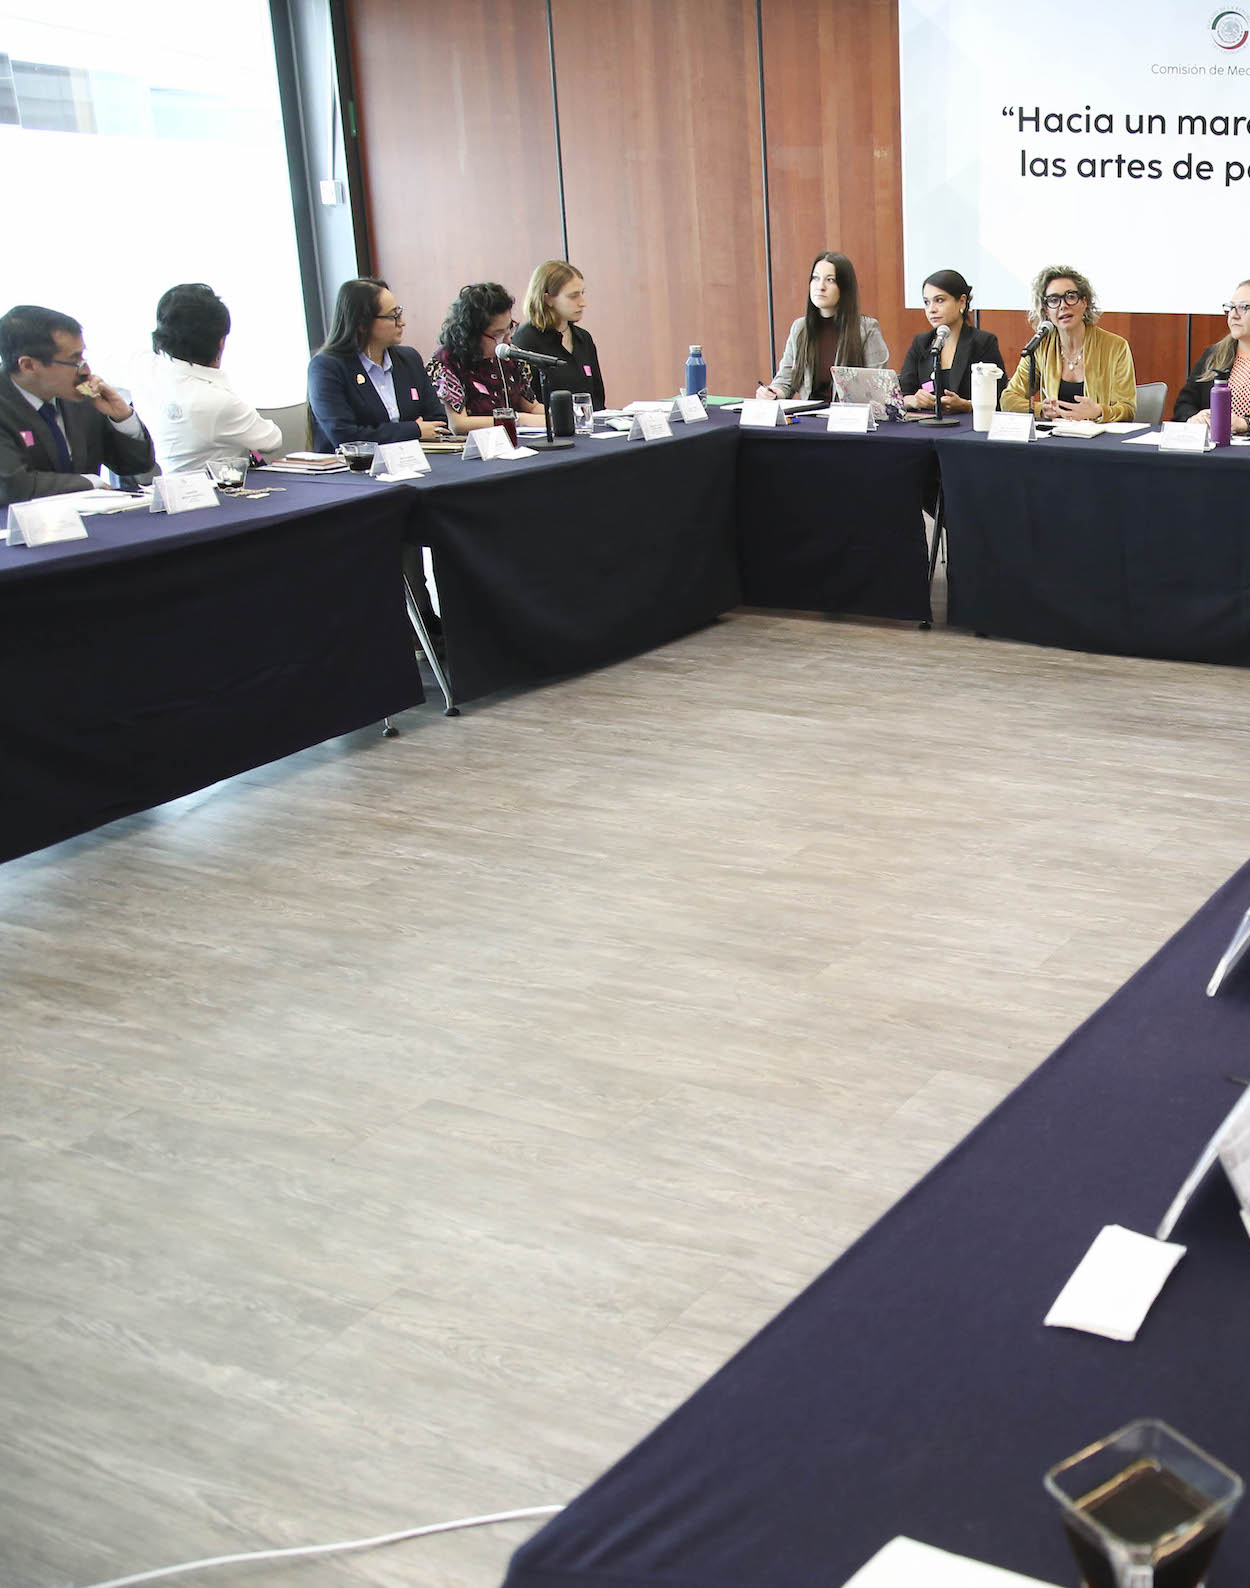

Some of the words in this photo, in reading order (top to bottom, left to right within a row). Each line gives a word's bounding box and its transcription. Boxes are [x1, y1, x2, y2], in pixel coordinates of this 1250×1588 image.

[1151, 64, 1205, 74] Comisión
[1209, 65, 1224, 75] de
[1003, 105, 1113, 133] “Hacia
[1126, 115, 1165, 134] un
[1022, 150, 1066, 177] las
[1077, 154, 1162, 179] artes
[1173, 153, 1213, 180] de
